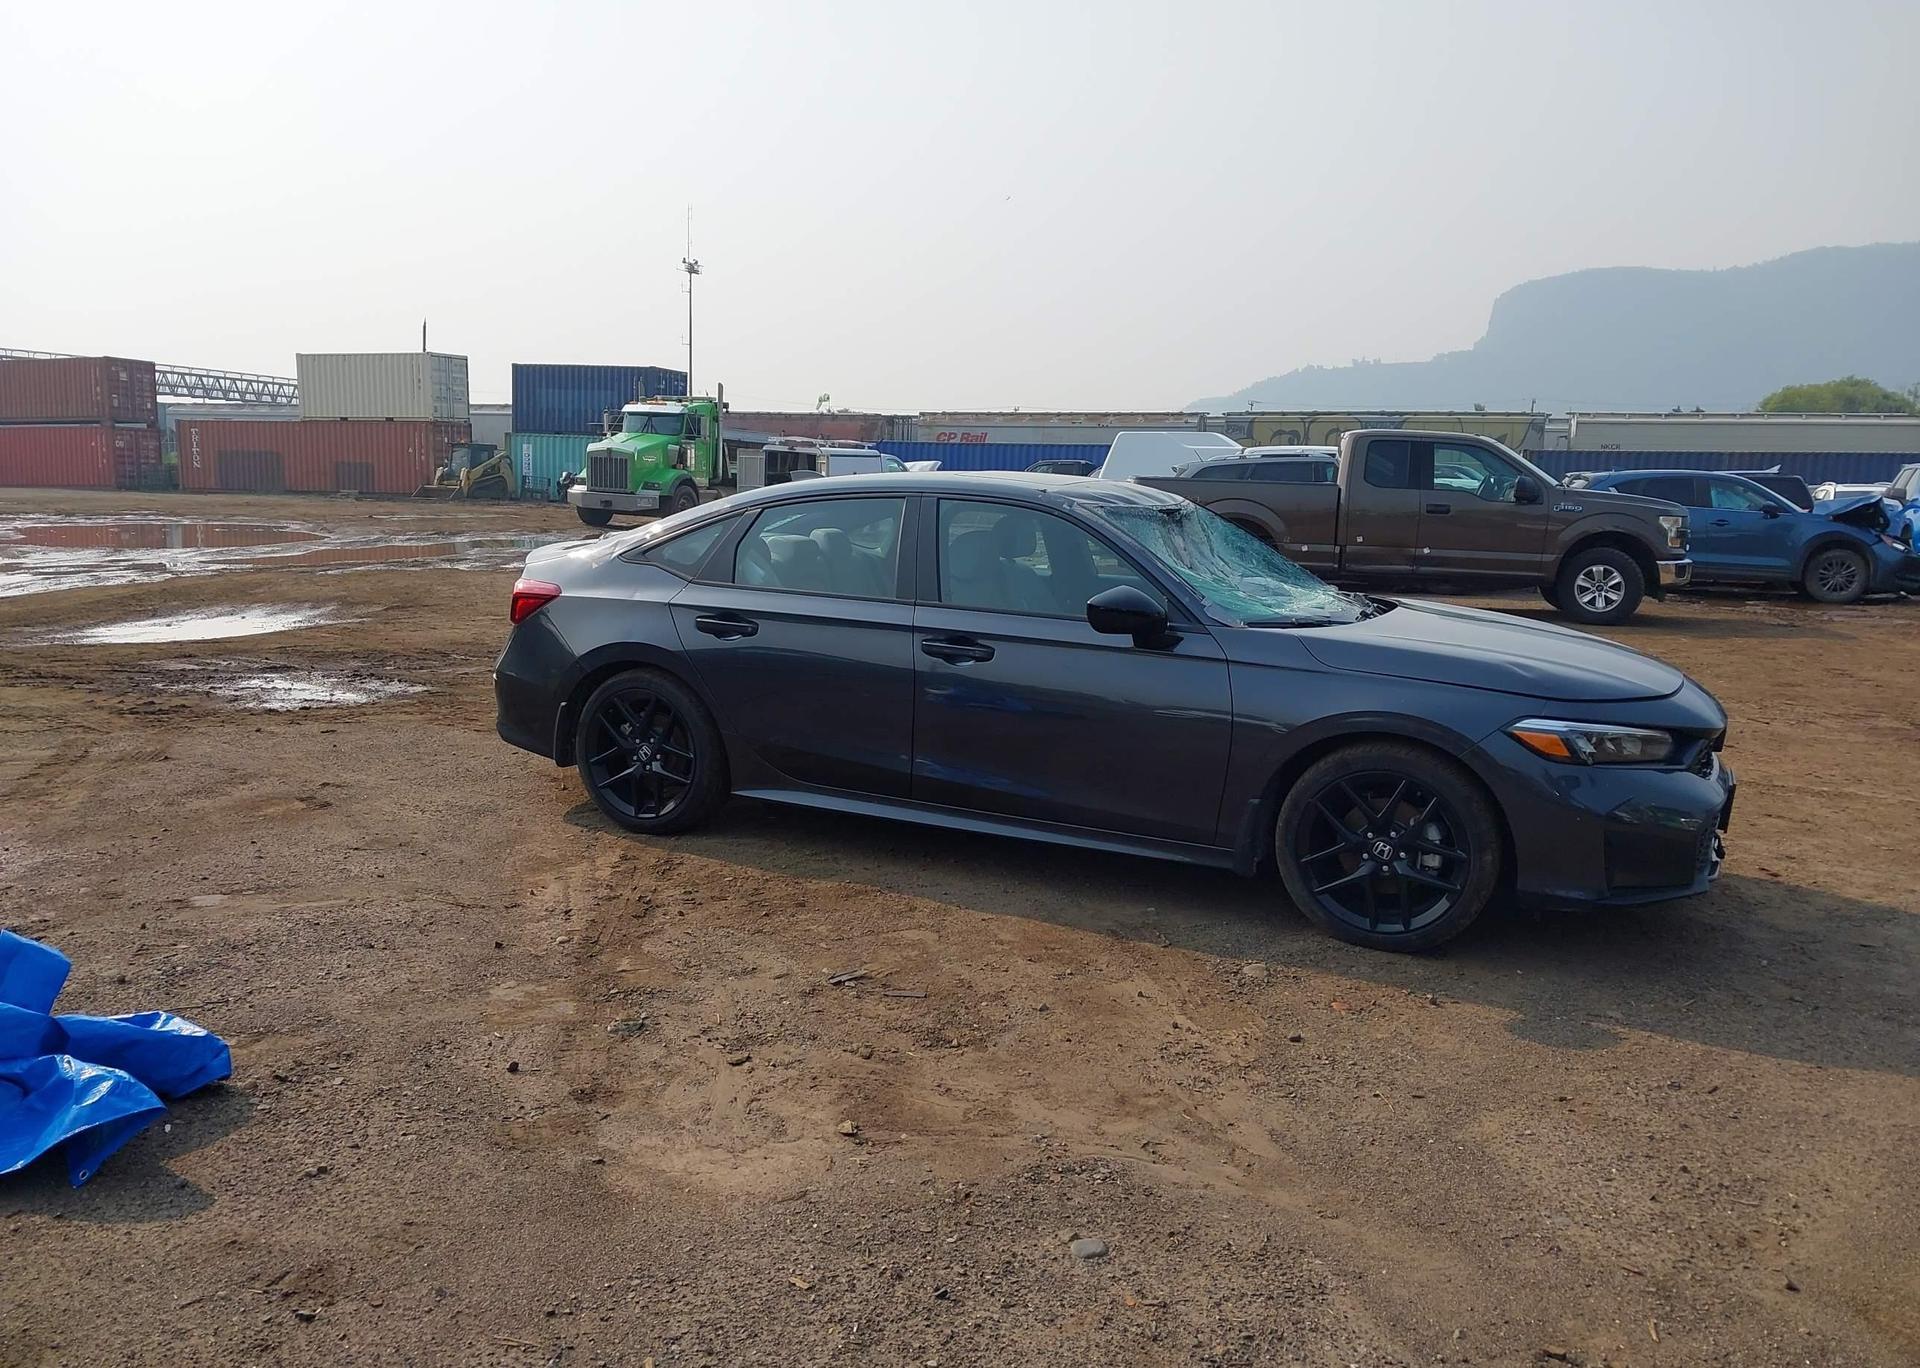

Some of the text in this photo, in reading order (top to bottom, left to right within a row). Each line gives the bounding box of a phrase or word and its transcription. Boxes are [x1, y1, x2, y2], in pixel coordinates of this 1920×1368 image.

[190, 428, 201, 468] TRITON
[936, 431, 988, 443] CP Rail
